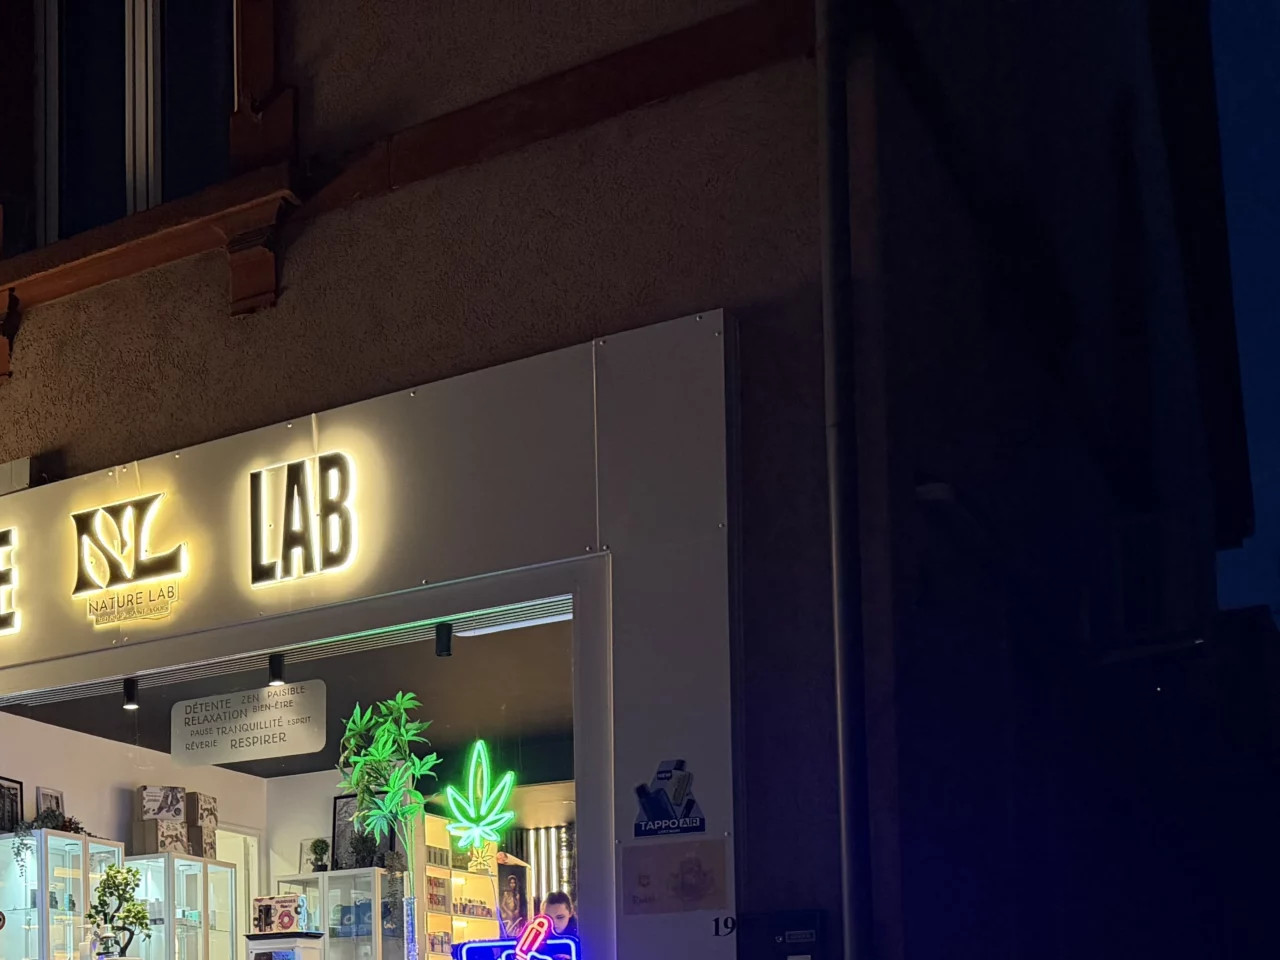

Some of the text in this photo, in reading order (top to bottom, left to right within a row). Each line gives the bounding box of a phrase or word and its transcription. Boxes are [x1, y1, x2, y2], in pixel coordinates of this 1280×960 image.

[249, 452, 357, 587] LAB
[89, 586, 175, 613] NATURE LAB
[184, 685, 306, 715] DÉTENTE ZEN PAISIBLE
[184, 699, 294, 727] RELAXATION BIEN-ÊTRE
[190, 716, 312, 738] PAUSE TRANQUILLITÉ ESPRIT
[230, 731, 287, 750] RESPIRER
[640, 817, 699, 830] TAPPO AIR
[712, 916, 737, 937] 19
